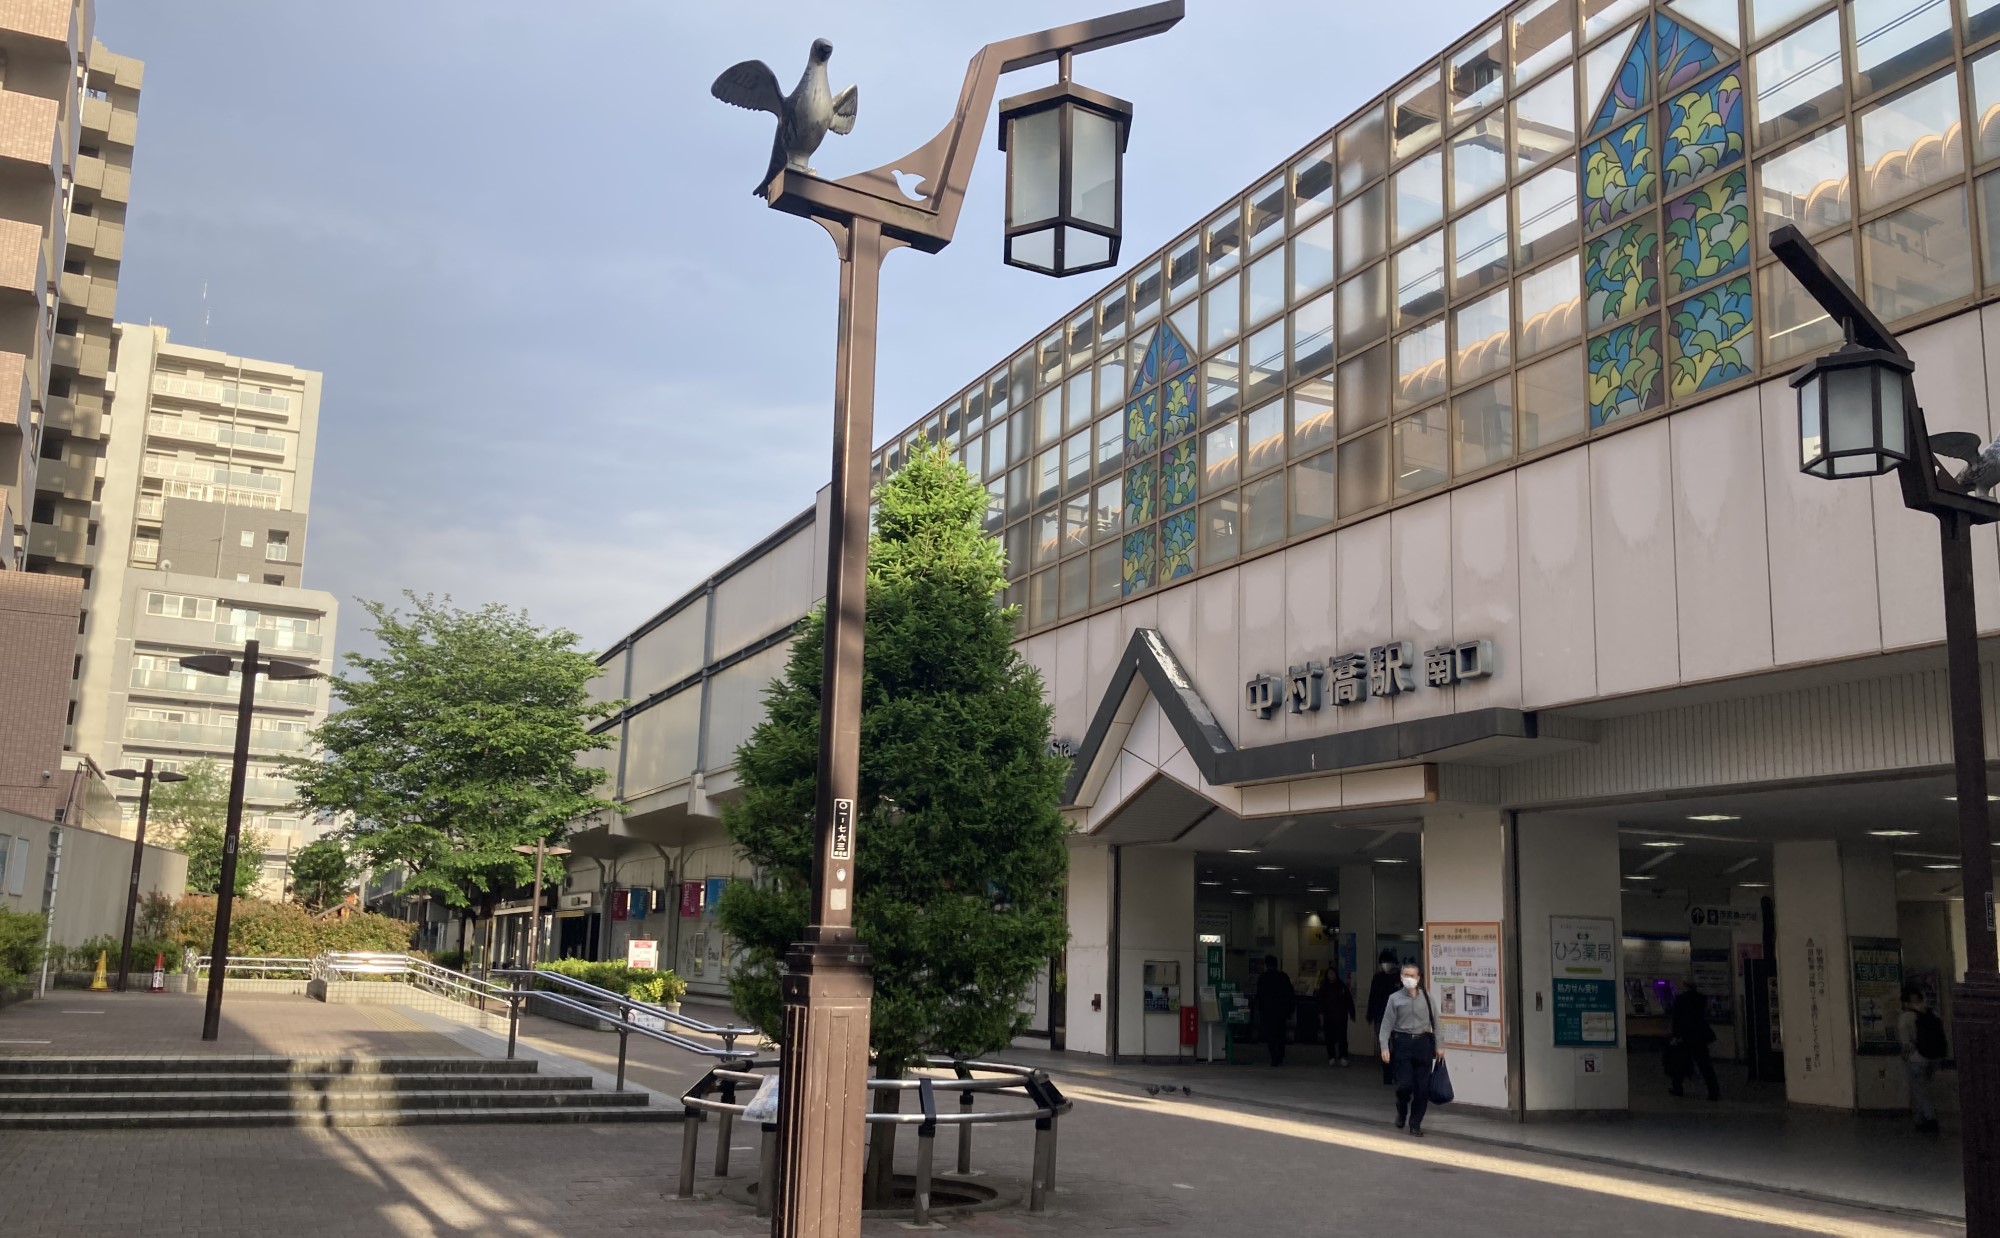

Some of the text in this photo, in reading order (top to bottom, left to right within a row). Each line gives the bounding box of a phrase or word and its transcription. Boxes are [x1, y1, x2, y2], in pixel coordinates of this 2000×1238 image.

[1246, 640, 1493, 720] 中村橋駅 南口
[1554, 942, 1612, 962] ひろ薬局
[1557, 983, 1599, 995] 処方せん受付
